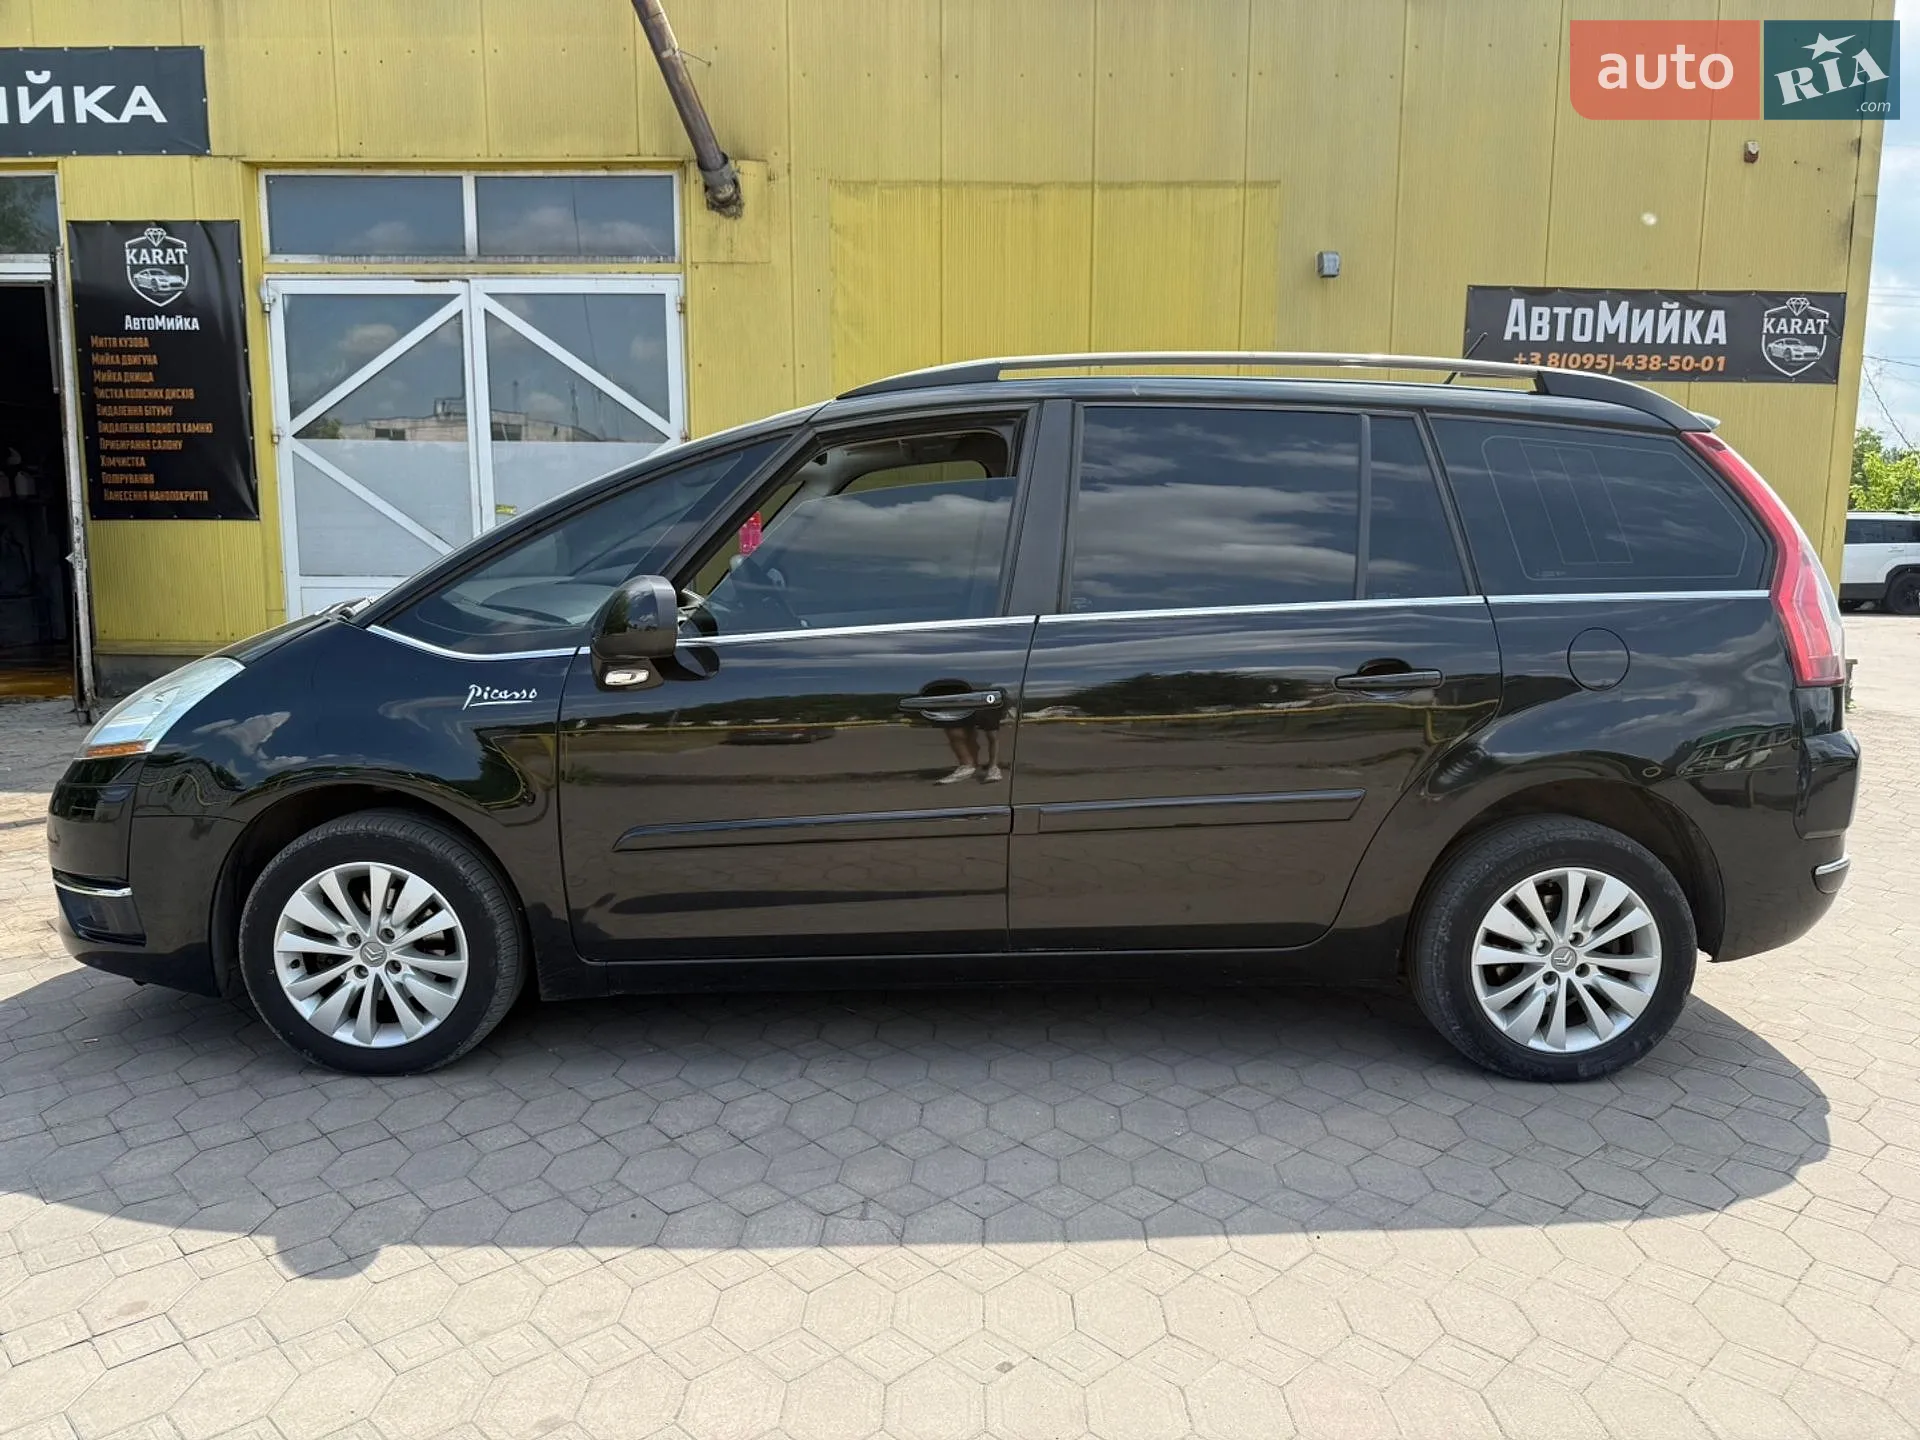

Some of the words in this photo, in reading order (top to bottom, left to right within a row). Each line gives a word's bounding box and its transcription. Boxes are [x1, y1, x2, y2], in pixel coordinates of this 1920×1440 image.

[0, 69, 168, 124] ЙКА
[125, 247, 188, 265] KARAT
[1762, 317, 1829, 335] KARAT
[462, 684, 538, 711] Picasso
